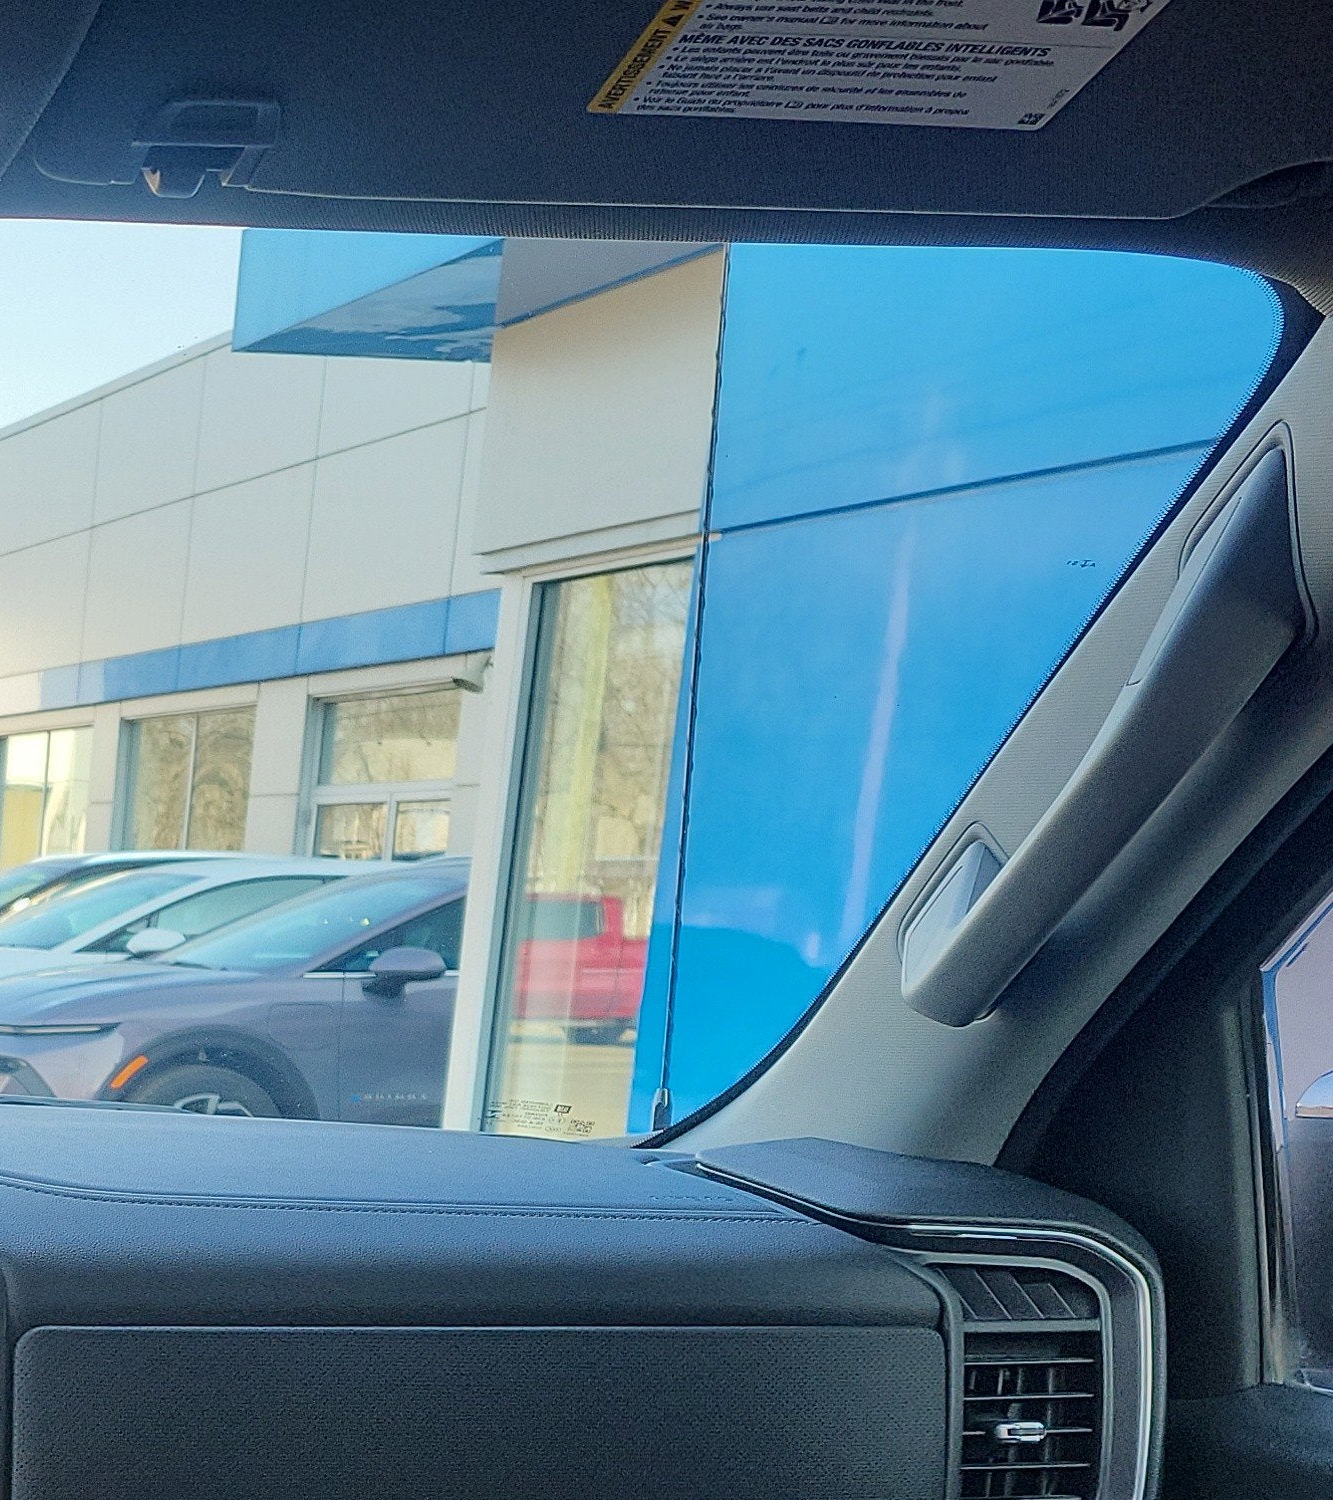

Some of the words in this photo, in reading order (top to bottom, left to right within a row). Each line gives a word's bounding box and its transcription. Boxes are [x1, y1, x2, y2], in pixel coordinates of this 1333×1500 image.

[706, 13, 728, 22] See
[729, 14, 775, 23] owner's
[776, 16, 819, 25] manual
[840, 17, 857, 26] for
[858, 19, 888, 27] more
[889, 20, 954, 29] information
[954, 22, 989, 31] about
[678, 32, 728, 45] MÊME
[727, 34, 770, 46] AVEC
[769, 36, 803, 47] DES
[802, 38, 846, 49] SACS
[846, 38, 945, 53] GONFLABLES
[945, 42, 1052, 58] INTELLIGENTS
